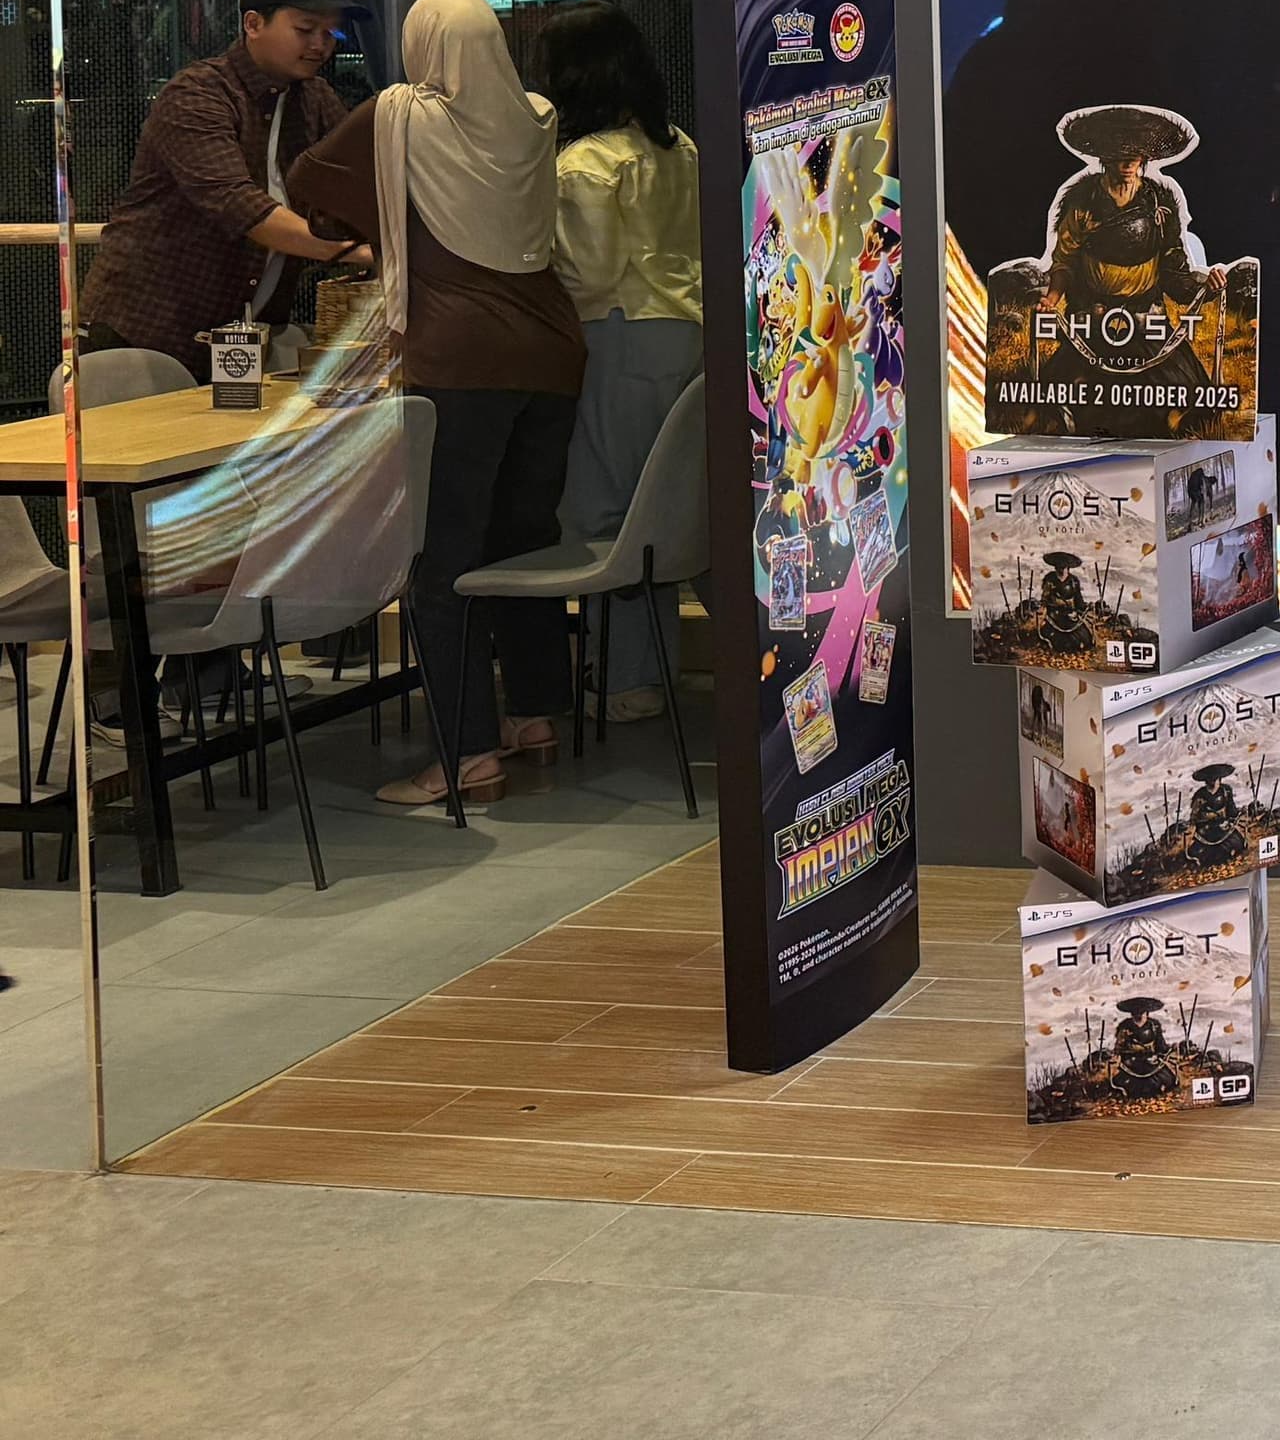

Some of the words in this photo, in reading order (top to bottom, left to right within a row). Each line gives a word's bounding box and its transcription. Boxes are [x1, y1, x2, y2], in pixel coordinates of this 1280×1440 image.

[834, 85, 865, 111] Mega
[866, 77, 890, 98] ex
[753, 136, 770, 153] dan
[771, 129, 800, 150] impian
[811, 105, 881, 141] genggamanmu!
[224, 334, 248, 344] NOTICE
[1035, 307, 1204, 346] GHOST
[999, 382, 1087, 405] AVAILABLE
[1094, 384, 1105, 406] 2
[1111, 384, 1188, 408] OCTOBER
[1195, 386, 1240, 409] 2025
[985, 457, 1009, 465] PS5
[995, 490, 1130, 520] GHOST
[1131, 646, 1153, 661] SP
[1125, 685, 1152, 698] PS5
[776, 790, 862, 857] EVOLUSI
[865, 761, 910, 810] MEGA
[786, 813, 876, 907] IMPIAN
[876, 789, 910, 854] ex
[1044, 910, 1073, 919] PS5
[815, 944, 843, 965] character
[1057, 933, 1219, 967] GHOST
[1222, 1080, 1247, 1093] SP
